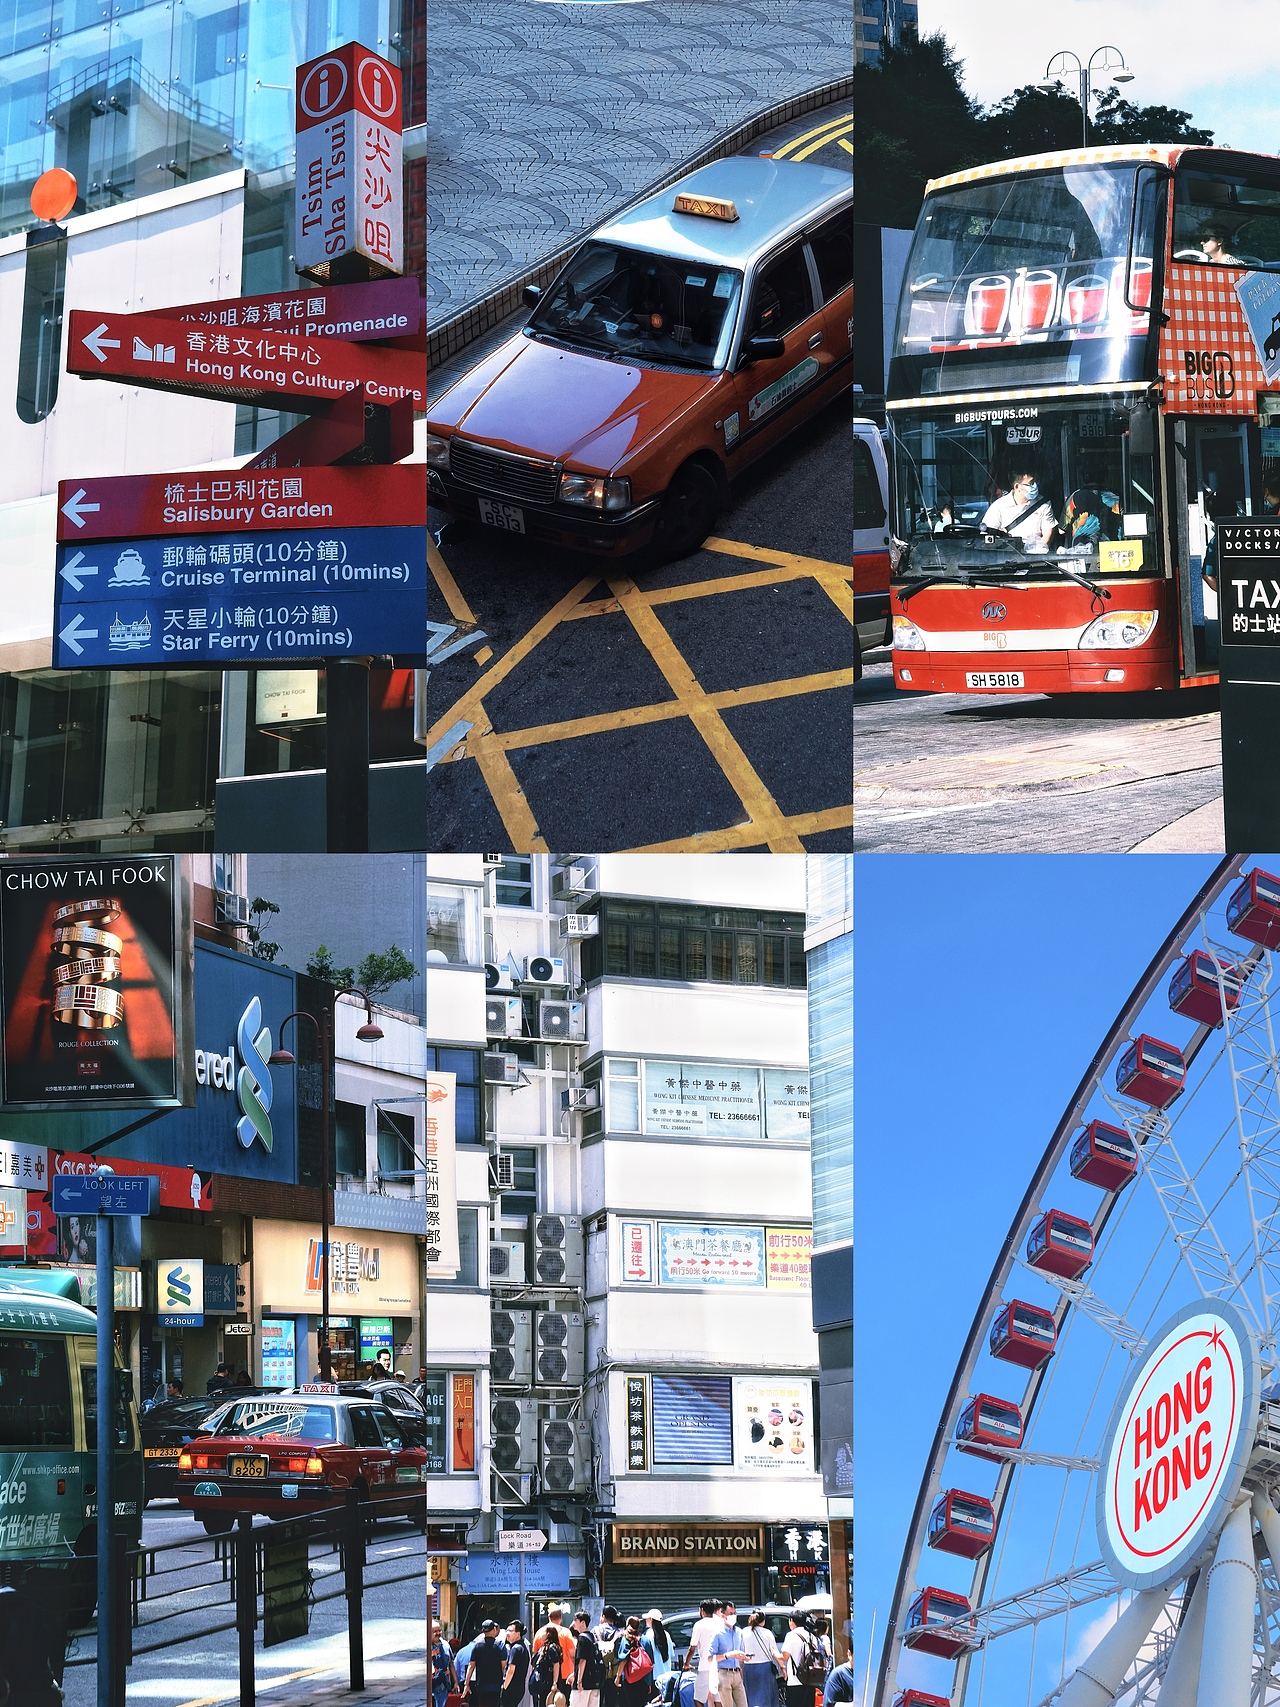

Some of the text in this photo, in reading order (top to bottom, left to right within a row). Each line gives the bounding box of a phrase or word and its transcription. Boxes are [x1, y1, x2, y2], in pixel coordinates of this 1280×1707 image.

[325, 119, 346, 255] Sha Tsui
[302, 157, 322, 236] Tsim
[365, 127, 394, 263] 尖沙咀
[679, 197, 726, 217] TAXI
[306, 313, 408, 337] Promenade
[186, 331, 322, 366] 香港文化中心
[1184, 351, 1213, 375] BIG
[186, 358, 234, 380] Hong
[240, 364, 287, 387] Kong
[292, 369, 360, 392] Cultural
[1186, 377, 1214, 399] BUS
[955, 407, 1038, 424] BIGBUSTOURS.COM
[164, 477, 303, 504] 梳士巴利花園
[163, 502, 333, 524] Salisbury Garden
[491, 502, 511, 518] SC
[485, 511, 520, 532] 8613
[162, 540, 348, 568] 郵輪碼頭(10分鐘)
[1112, 551, 1132, 568] 16
[161, 562, 411, 587] Cruise Terminal (10mins)
[162, 605, 339, 631] 天星小輪(10分鐘)
[162, 628, 353, 651] Star Ferry (10mins)
[984, 632, 996, 641] BIG
[972, 673, 1019, 687] SH 5818
[6, 865, 166, 890] CHOW TAI FOOK
[80, 1039, 119, 1048] COLLECTION
[195, 1046, 235, 1091] ered
[1157, 1060, 1169, 1068] AIA
[721, 1096, 754, 1104] PRACTITIONER
[709, 1112, 760, 1122] TEL: 23666661
[1110, 1144, 1122, 1152] AIA
[84, 1180, 144, 1191] LOOK LEFT
[99, 1194, 128, 1209] 望左
[682, 1239, 742, 1254] 澳門茶餐廳
[769, 1234, 813, 1248] 前行50米
[1066, 1235, 1077, 1243] AIA
[670, 1266, 701, 1276] 前行50米
[0, 1309, 59, 1326] 士十九座位
[164, 1317, 195, 1325] 24-hour
[1028, 1325, 1040, 1333] AIA
[303, 1384, 335, 1393] TAXI
[454, 1378, 473, 1393] 正門
[426, 1395, 444, 1406] AGE
[454, 1395, 473, 1409] 入口
[1134, 1356, 1213, 1470] HONG
[149, 1448, 178, 1457] GT 2336
[22, 1465, 80, 1475] www.shkp-office.com
[243, 1458, 255, 1468] VK
[235, 1467, 262, 1476] 8209
[1134, 1420, 1213, 1533] KONG
[1, 1481, 27, 1504] ace
[966, 1516, 978, 1524] AIA
[508, 1541, 524, 1549] 樂道
[621, 1536, 757, 1550] BRAND STATION
[784, 1528, 828, 1550] 香港
[790, 1552, 822, 1560] H K
[490, 1567, 506, 1575] Wing
[782, 1564, 816, 1575] Canon
